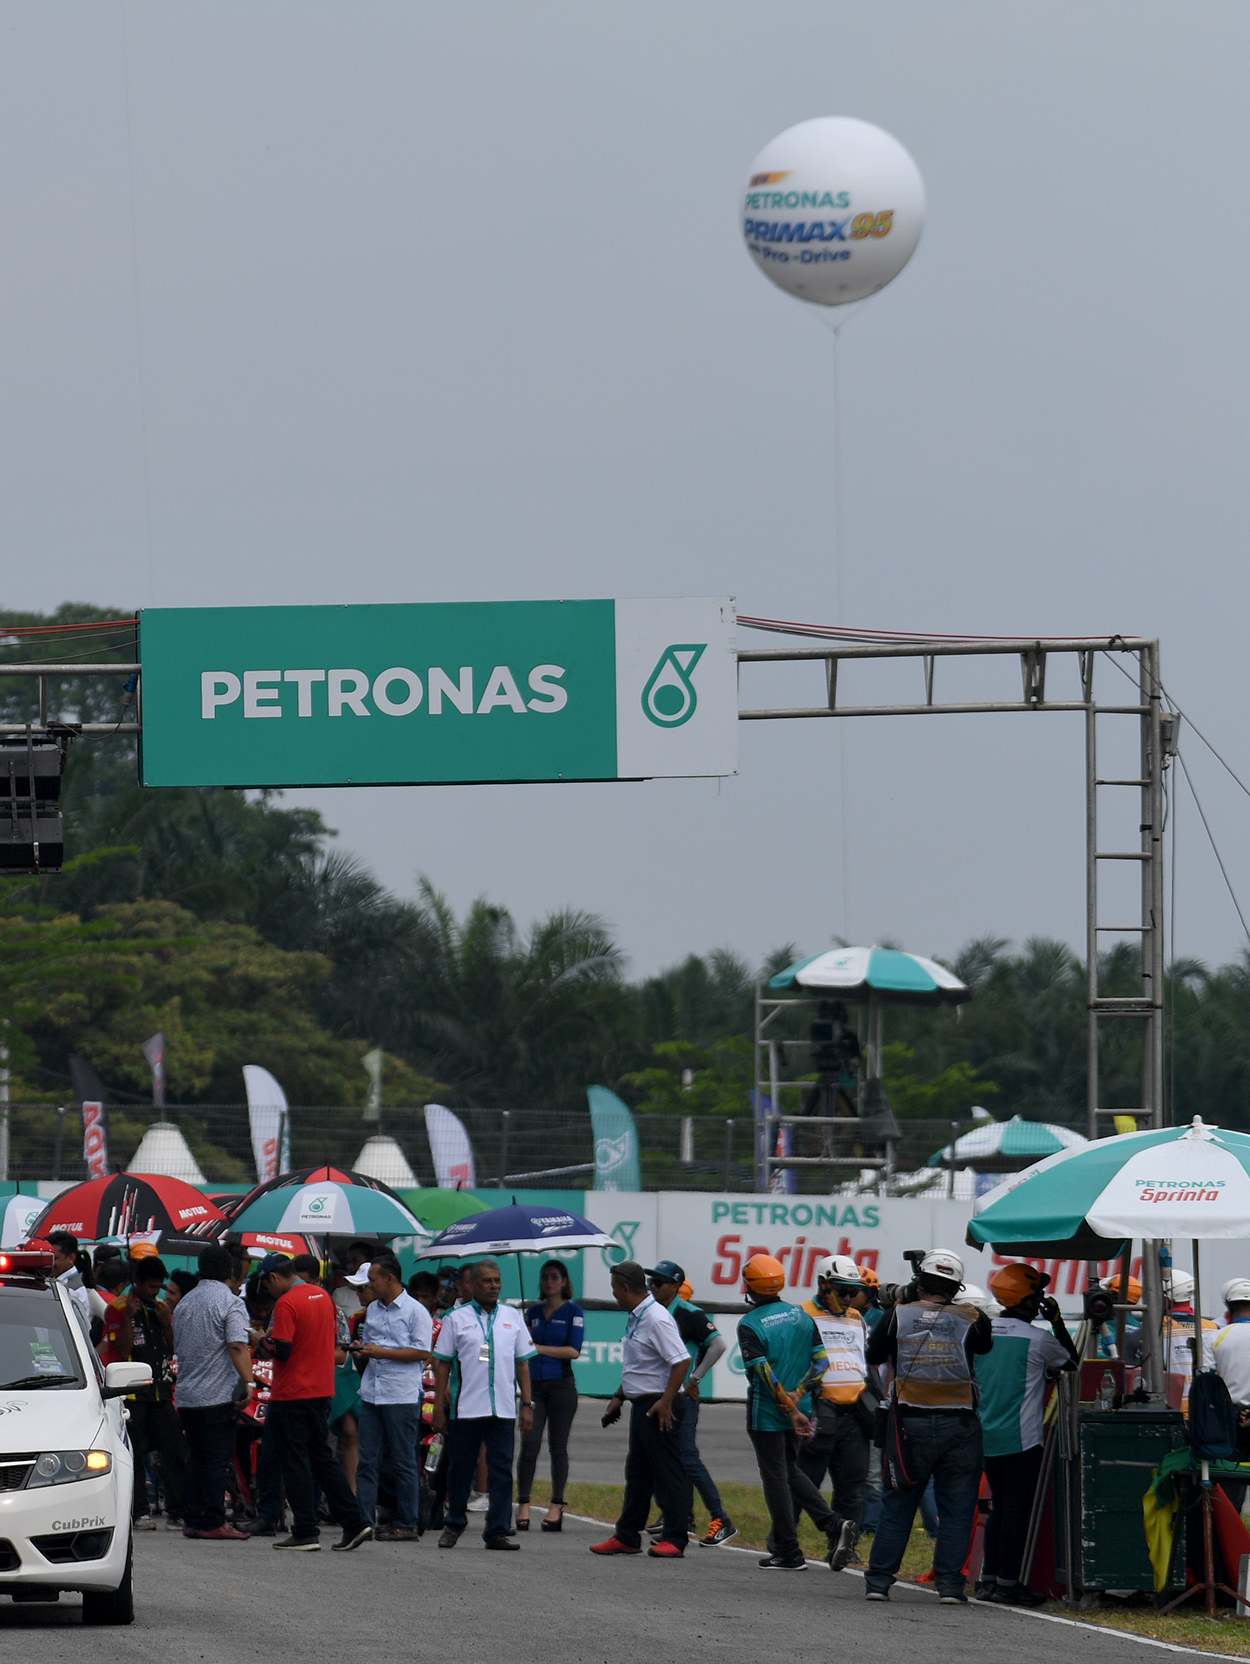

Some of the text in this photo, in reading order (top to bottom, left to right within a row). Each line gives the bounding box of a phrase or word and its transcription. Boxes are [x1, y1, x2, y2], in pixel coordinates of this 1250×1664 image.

[745, 191, 851, 210] PETRONAS
[744, 209, 896, 243] PRIMAX 95
[200, 664, 569, 720] PETRONAS
[1135, 1179, 1226, 1189] PETRONAS
[1139, 1188, 1220, 1204] Sprinta
[179, 1205, 208, 1219] MOTUL
[711, 1200, 881, 1228] PETRONAS
[49, 1222, 84, 1233] MOTUL
[255, 1234, 294, 1250] MOTUL
[760, 1311, 788, 1324] PETRONAS
[763, 1316, 796, 1329] CubPrix
[827, 1361, 861, 1372] MEDIA
[51, 1516, 106, 1531] CubPrix
